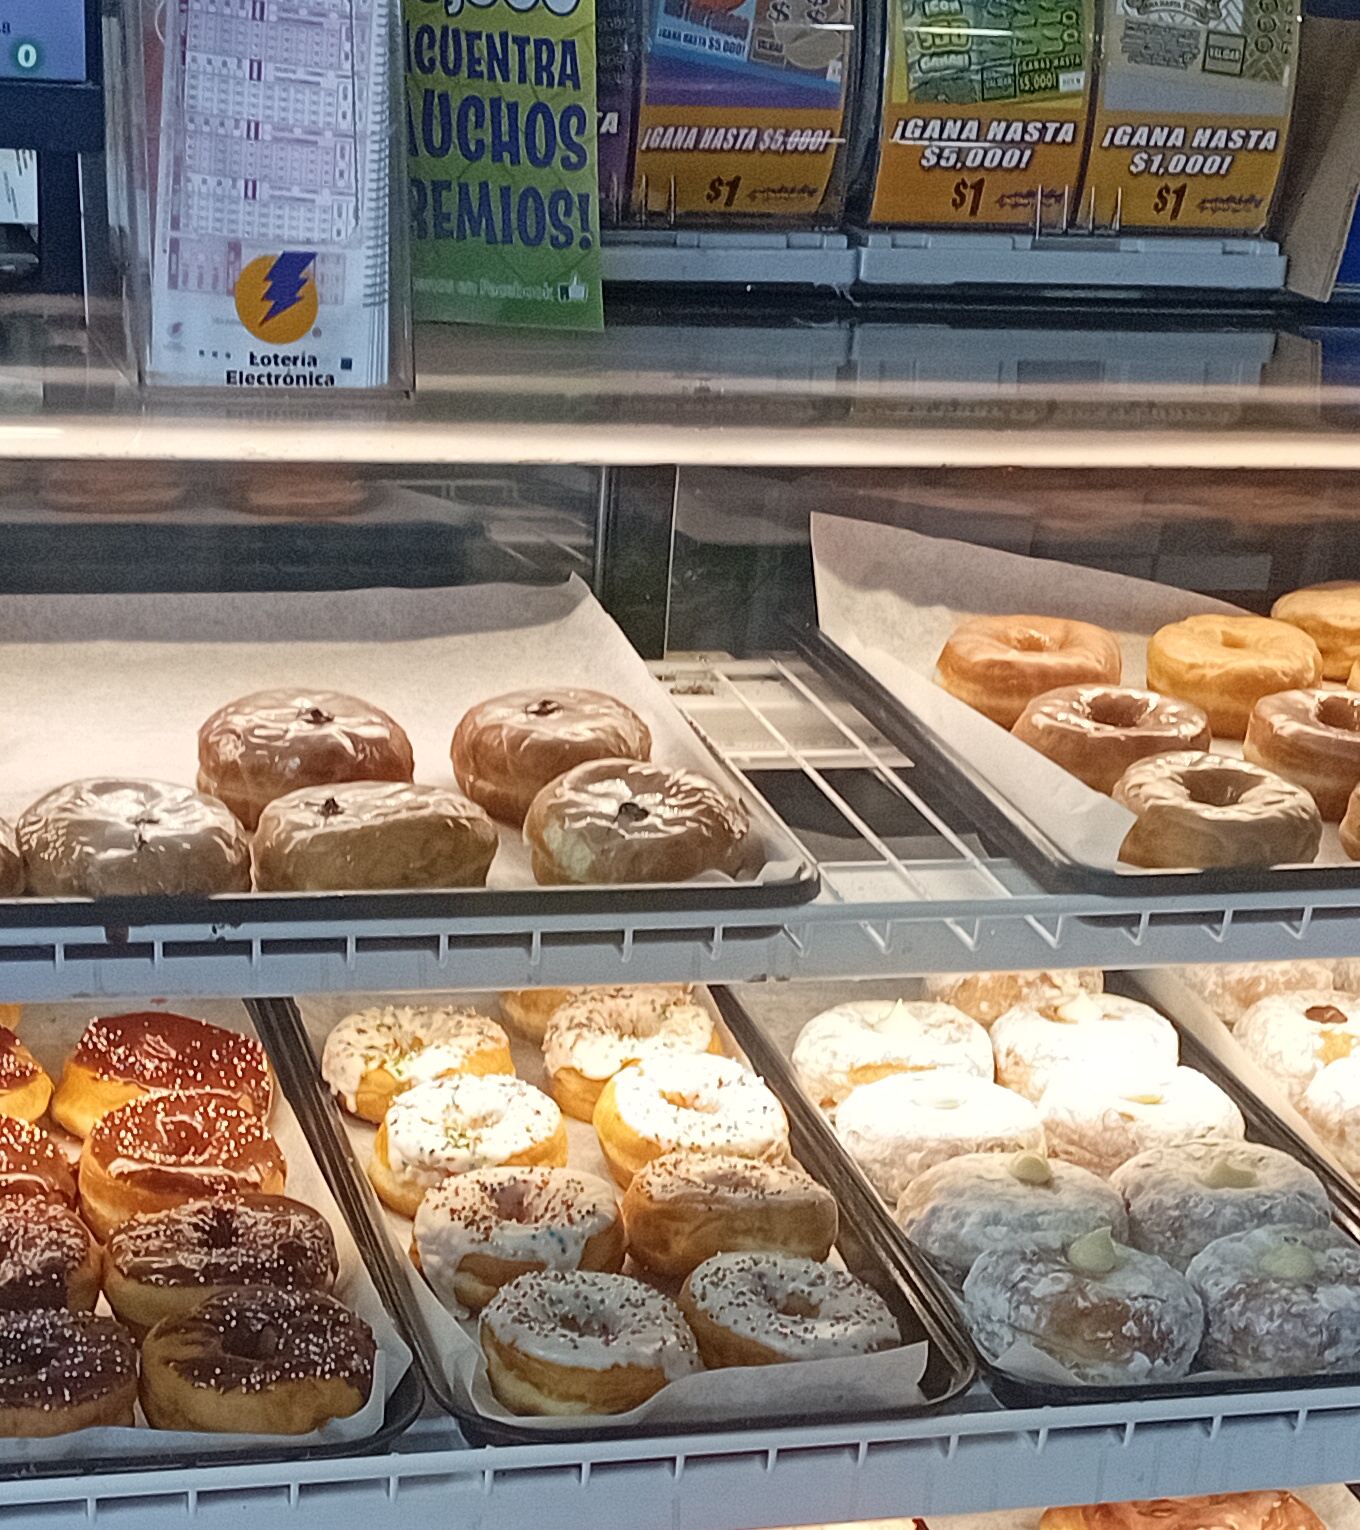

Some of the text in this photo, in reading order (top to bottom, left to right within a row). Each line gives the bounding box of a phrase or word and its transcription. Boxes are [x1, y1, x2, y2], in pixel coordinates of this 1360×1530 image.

[17, 43, 37, 68] 0
[406, 20, 581, 91] CUENTRA
[699, 127, 758, 151] HASTA
[892, 118, 1075, 143] ¡GANA HASTA
[1101, 125, 1278, 151] ¡GANA HASTA
[920, 144, 1033, 171] $5,000!
[1128, 151, 1233, 176] $1,000!
[705, 175, 742, 208] $1
[951, 176, 986, 217] $1
[1153, 182, 1188, 222] $1
[248, 350, 318, 367] Lotería
[225, 368, 336, 387] Electrónica
